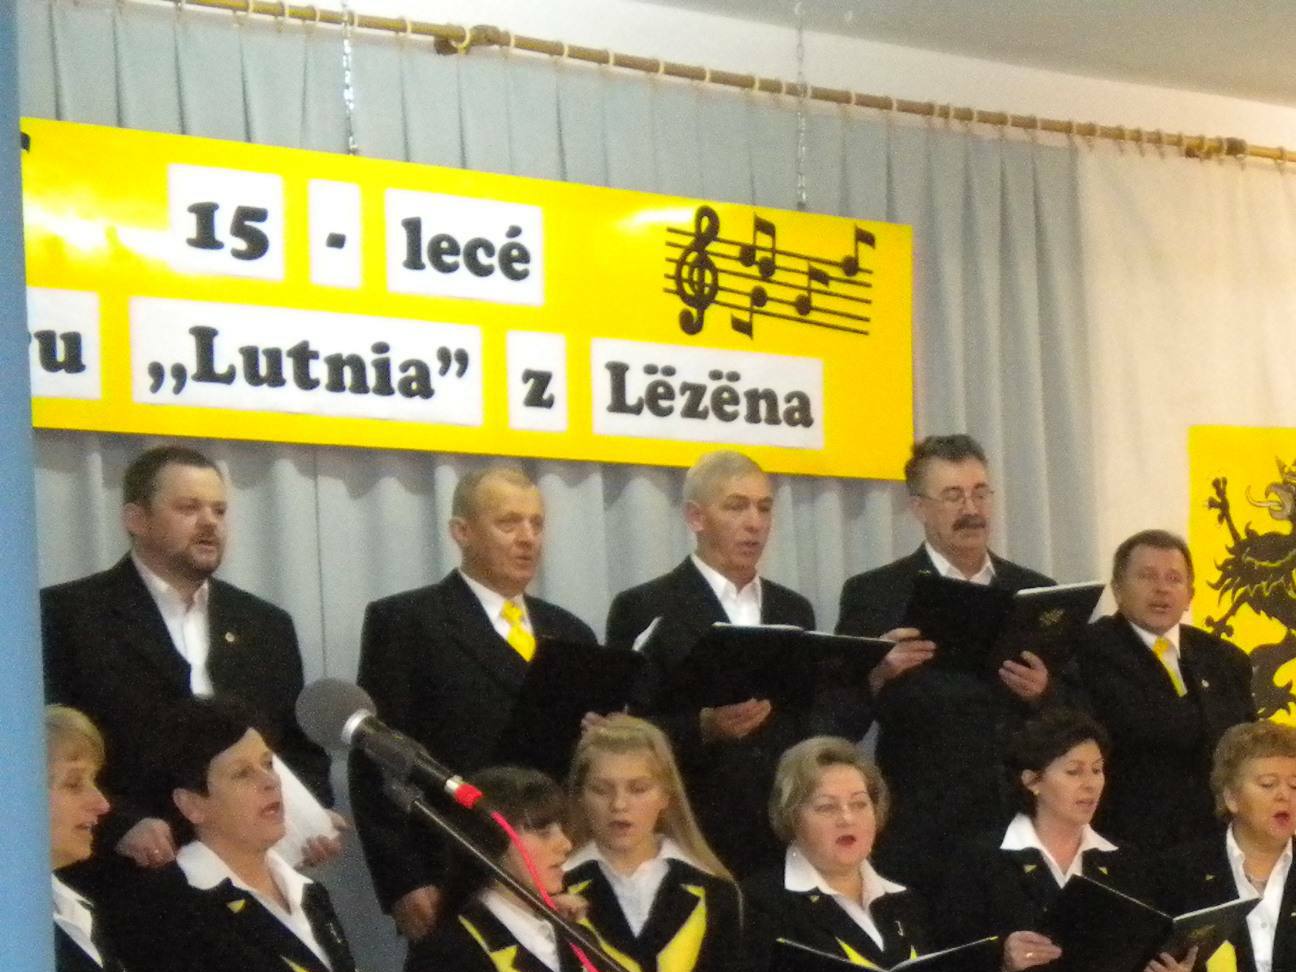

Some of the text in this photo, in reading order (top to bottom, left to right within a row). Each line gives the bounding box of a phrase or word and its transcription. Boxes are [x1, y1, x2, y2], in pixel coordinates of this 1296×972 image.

[186, 202, 270, 261] 15
[401, 216, 531, 282] lecé
[29, 329, 87, 374] u
[522, 368, 555, 409] z
[605, 360, 814, 429] Lëzëna
